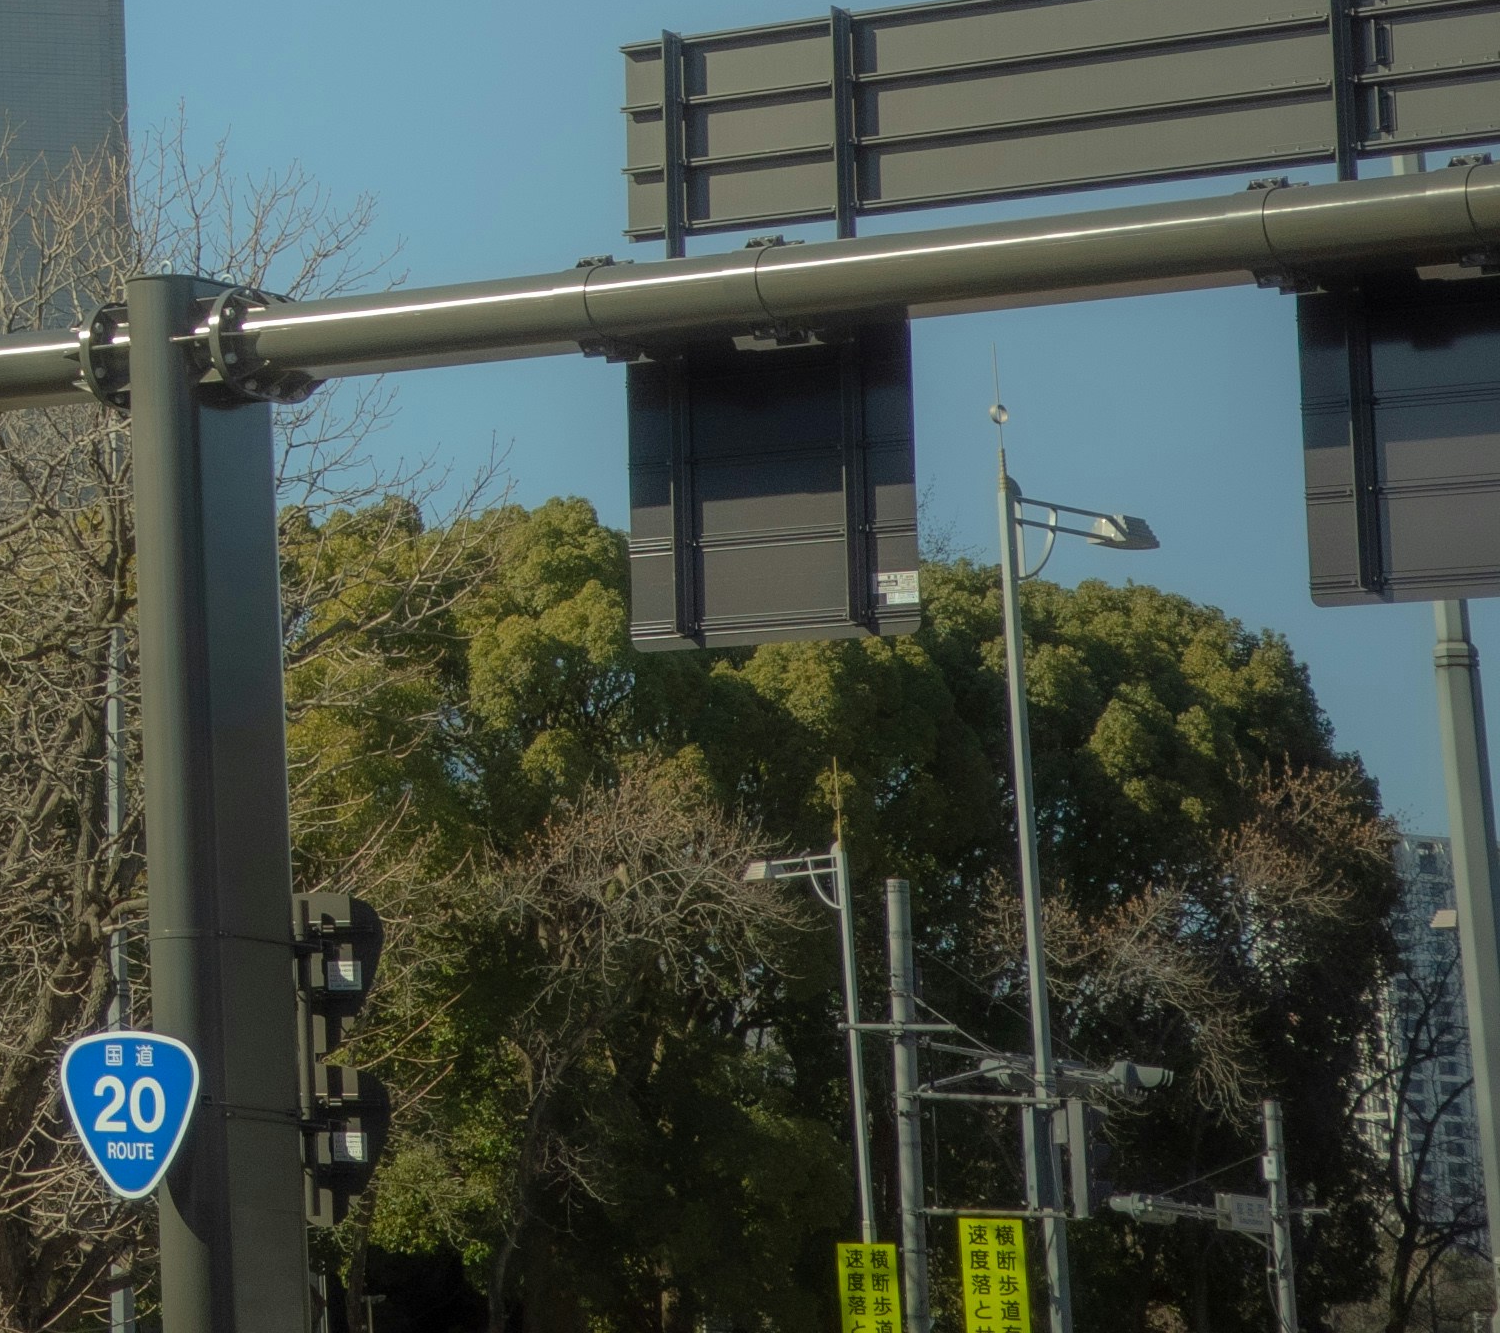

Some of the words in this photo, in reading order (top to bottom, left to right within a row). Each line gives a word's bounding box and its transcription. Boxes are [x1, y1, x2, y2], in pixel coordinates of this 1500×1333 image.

[105, 1044, 154, 1067] 国道
[93, 1075, 166, 1134] 20
[107, 1141, 155, 1160] ROUTE
